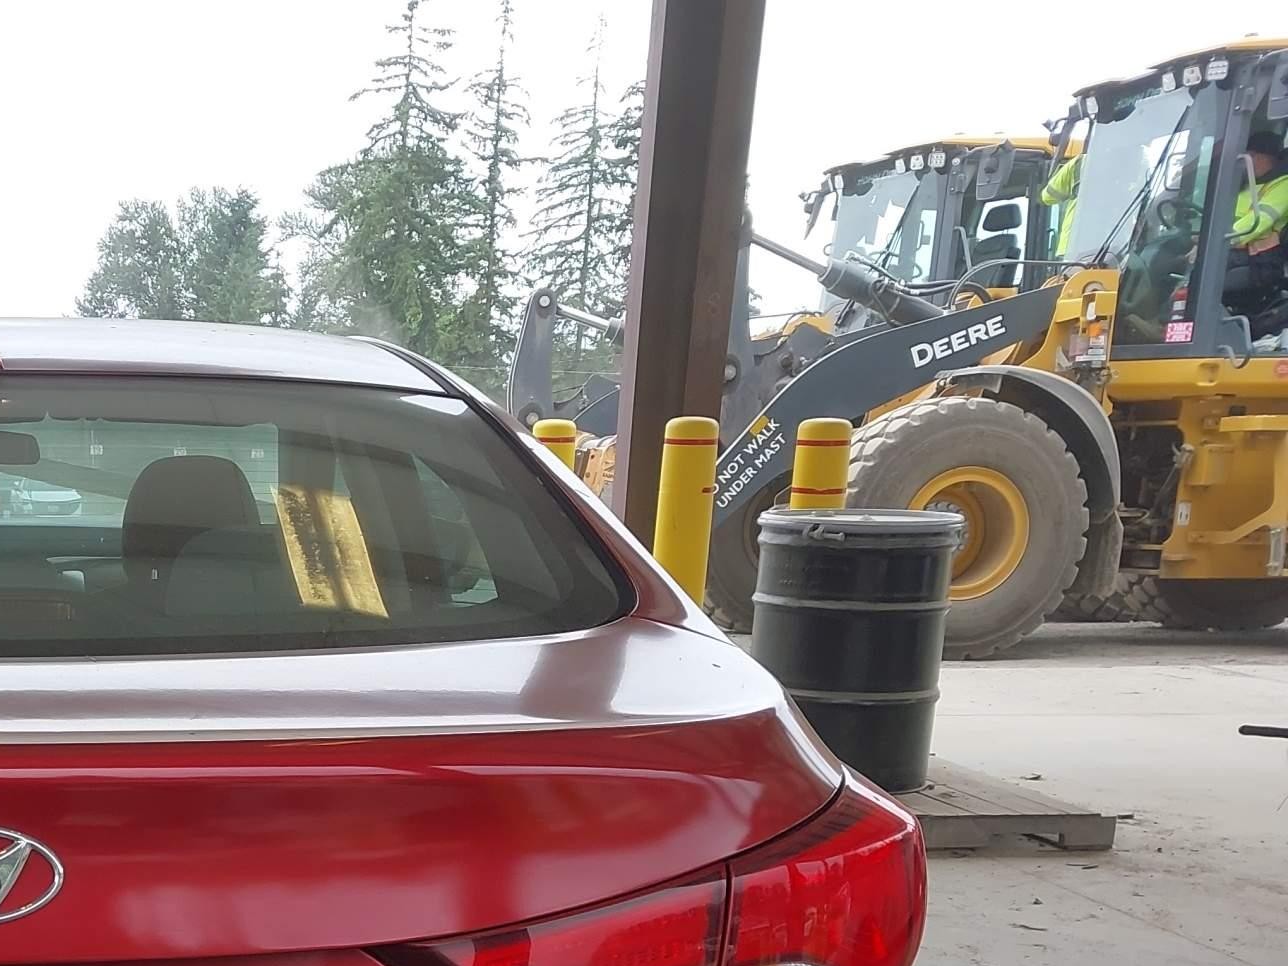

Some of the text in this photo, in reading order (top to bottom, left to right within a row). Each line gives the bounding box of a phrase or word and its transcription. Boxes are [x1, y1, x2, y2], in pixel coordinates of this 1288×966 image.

[910, 315, 1006, 368] DEERE
[716, 432, 786, 508] UNDER MAST
[717, 453, 745, 484] NOT
[743, 418, 780, 455] WALK
